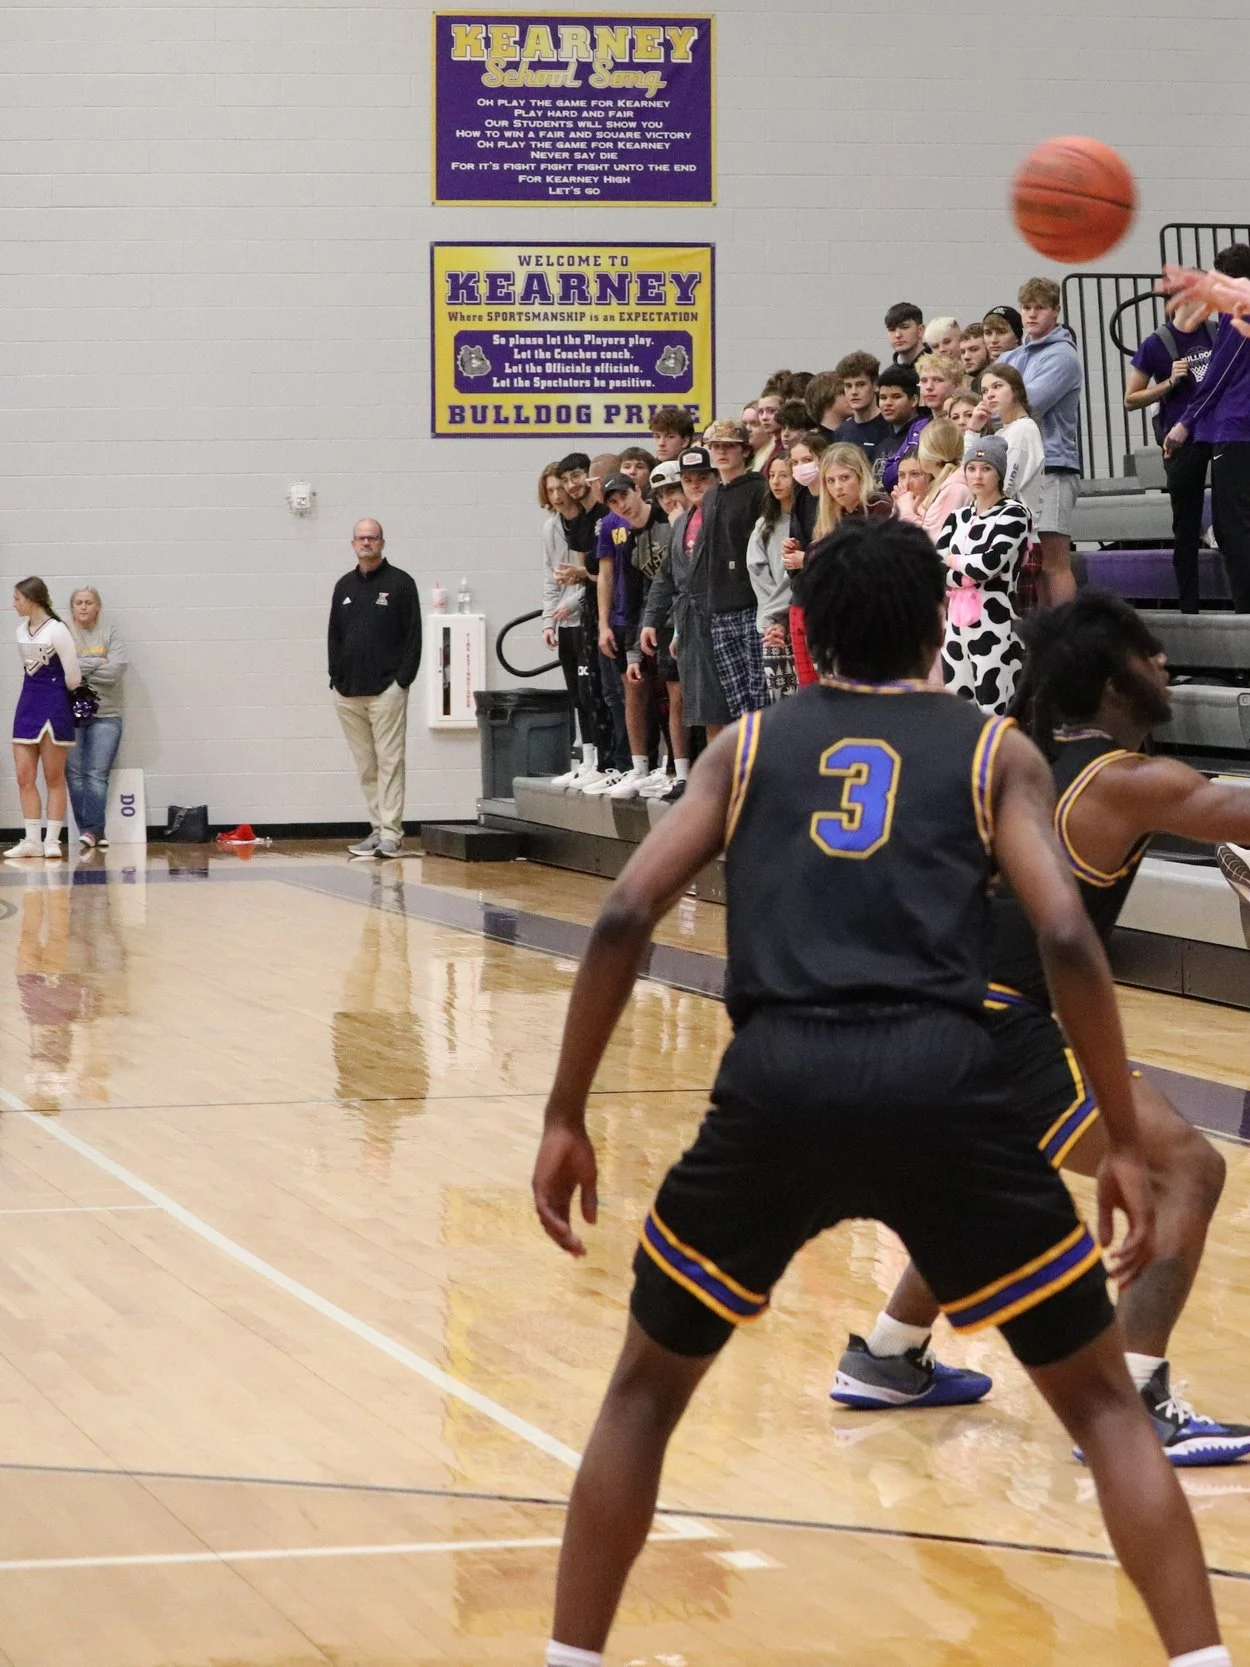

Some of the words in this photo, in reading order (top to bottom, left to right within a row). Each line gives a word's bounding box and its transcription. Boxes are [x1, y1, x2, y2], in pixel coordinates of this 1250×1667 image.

[451, 24, 699, 63] KEARNEY
[481, 57, 582, 88] School
[589, 58, 667, 98] Song
[517, 255, 602, 267] WELCOME
[608, 255, 629, 267] TO
[446, 271, 702, 306] KEARNEY
[448, 311, 483, 322] Where
[487, 311, 586, 322] SPORTSMANSHIP
[589, 311, 599, 322] is
[603, 314, 615, 322] an
[619, 311, 698, 322] EXPECTATION
[492, 334, 506, 345] So
[508, 334, 544, 348] please
[546, 334, 561, 345] let
[564, 334, 581, 345] the
[583, 334, 626, 348] Players
[628, 334, 654, 348] play.
[513, 348, 532, 359] Let
[534, 348, 552, 359] the
[554, 348, 598, 360] Coaches
[600, 348, 634, 359] coach.
[504, 362, 523, 374] Let
[525, 362, 543, 374] the
[545, 362, 592, 374] Officials
[594, 362, 643, 374] officiate.
[492, 376, 511, 388] Let
[513, 376, 531, 388] the
[533, 376, 591, 390] Spectators
[593, 376, 606, 388] be
[608, 377, 656, 390] positive.
[448, 405, 593, 424] BULLDOG
[604, 404, 700, 424] PRIE
[810, 737, 902, 860] 3
